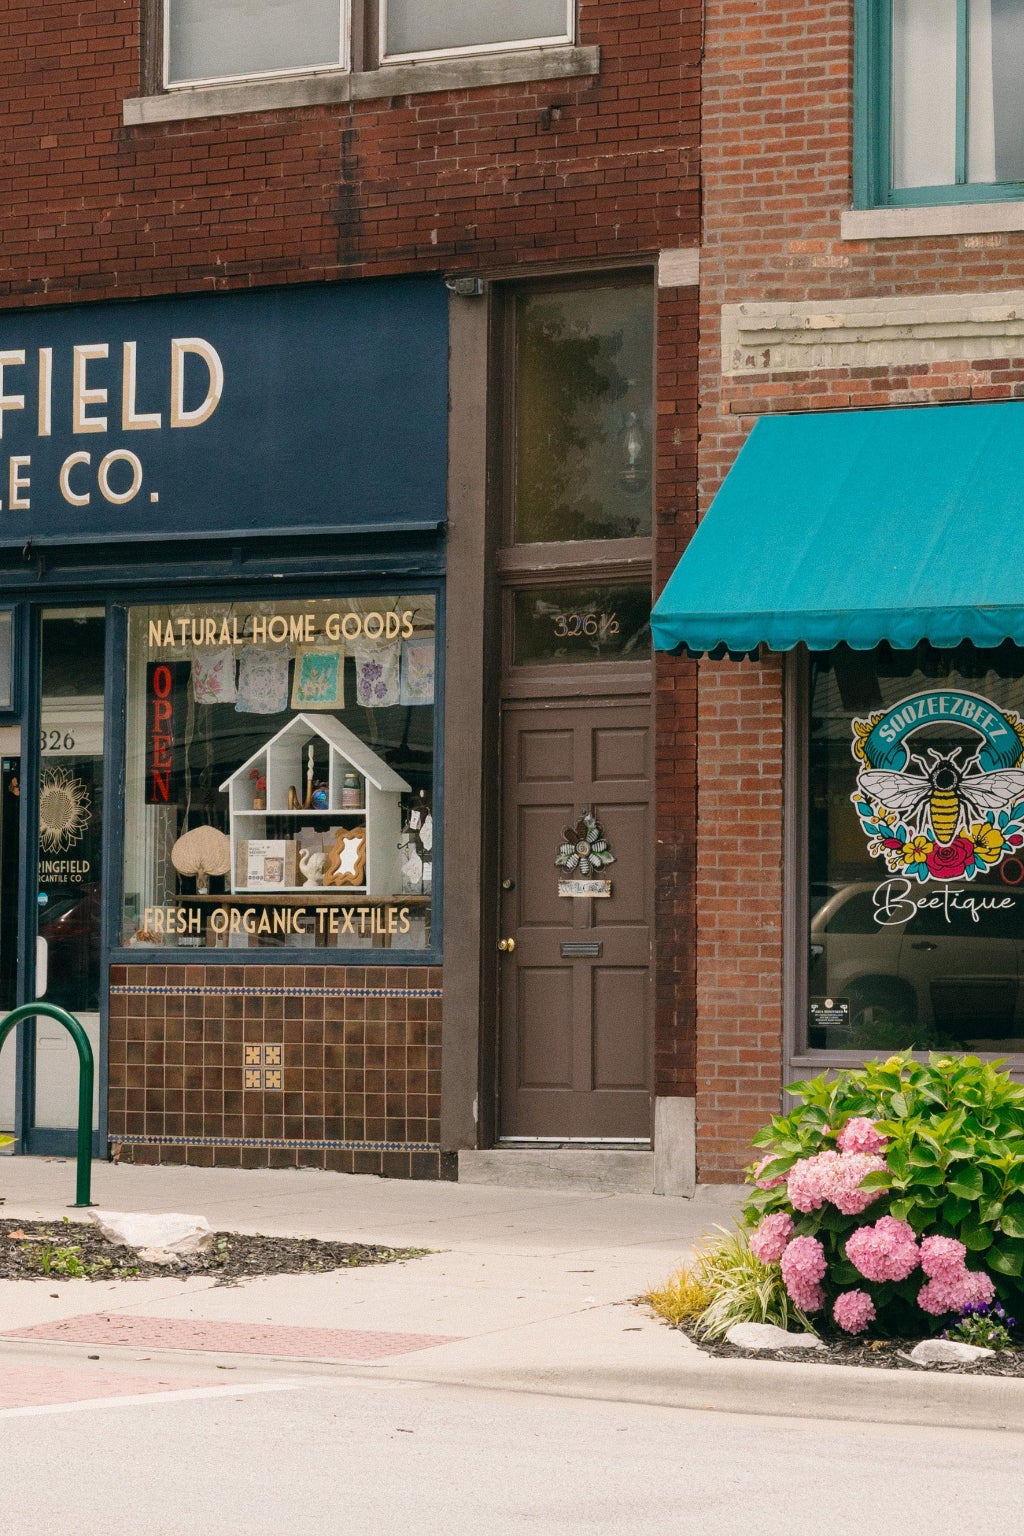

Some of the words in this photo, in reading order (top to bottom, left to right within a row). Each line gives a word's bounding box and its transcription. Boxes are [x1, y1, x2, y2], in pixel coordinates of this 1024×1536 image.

[59, 448, 160, 507] CO.
[148, 617, 243, 648] NATURAL
[252, 614, 315, 644] HOME
[325, 610, 414, 641] GOODS
[151, 665, 173, 803] OPEN
[878, 695, 1008, 744] SOOZEEZBEEZ
[143, 908, 201, 935] FRESH
[210, 907, 306, 935] ORGANIC
[316, 907, 411, 935] TEXTILES
[872, 878, 1016, 925] Beetique
